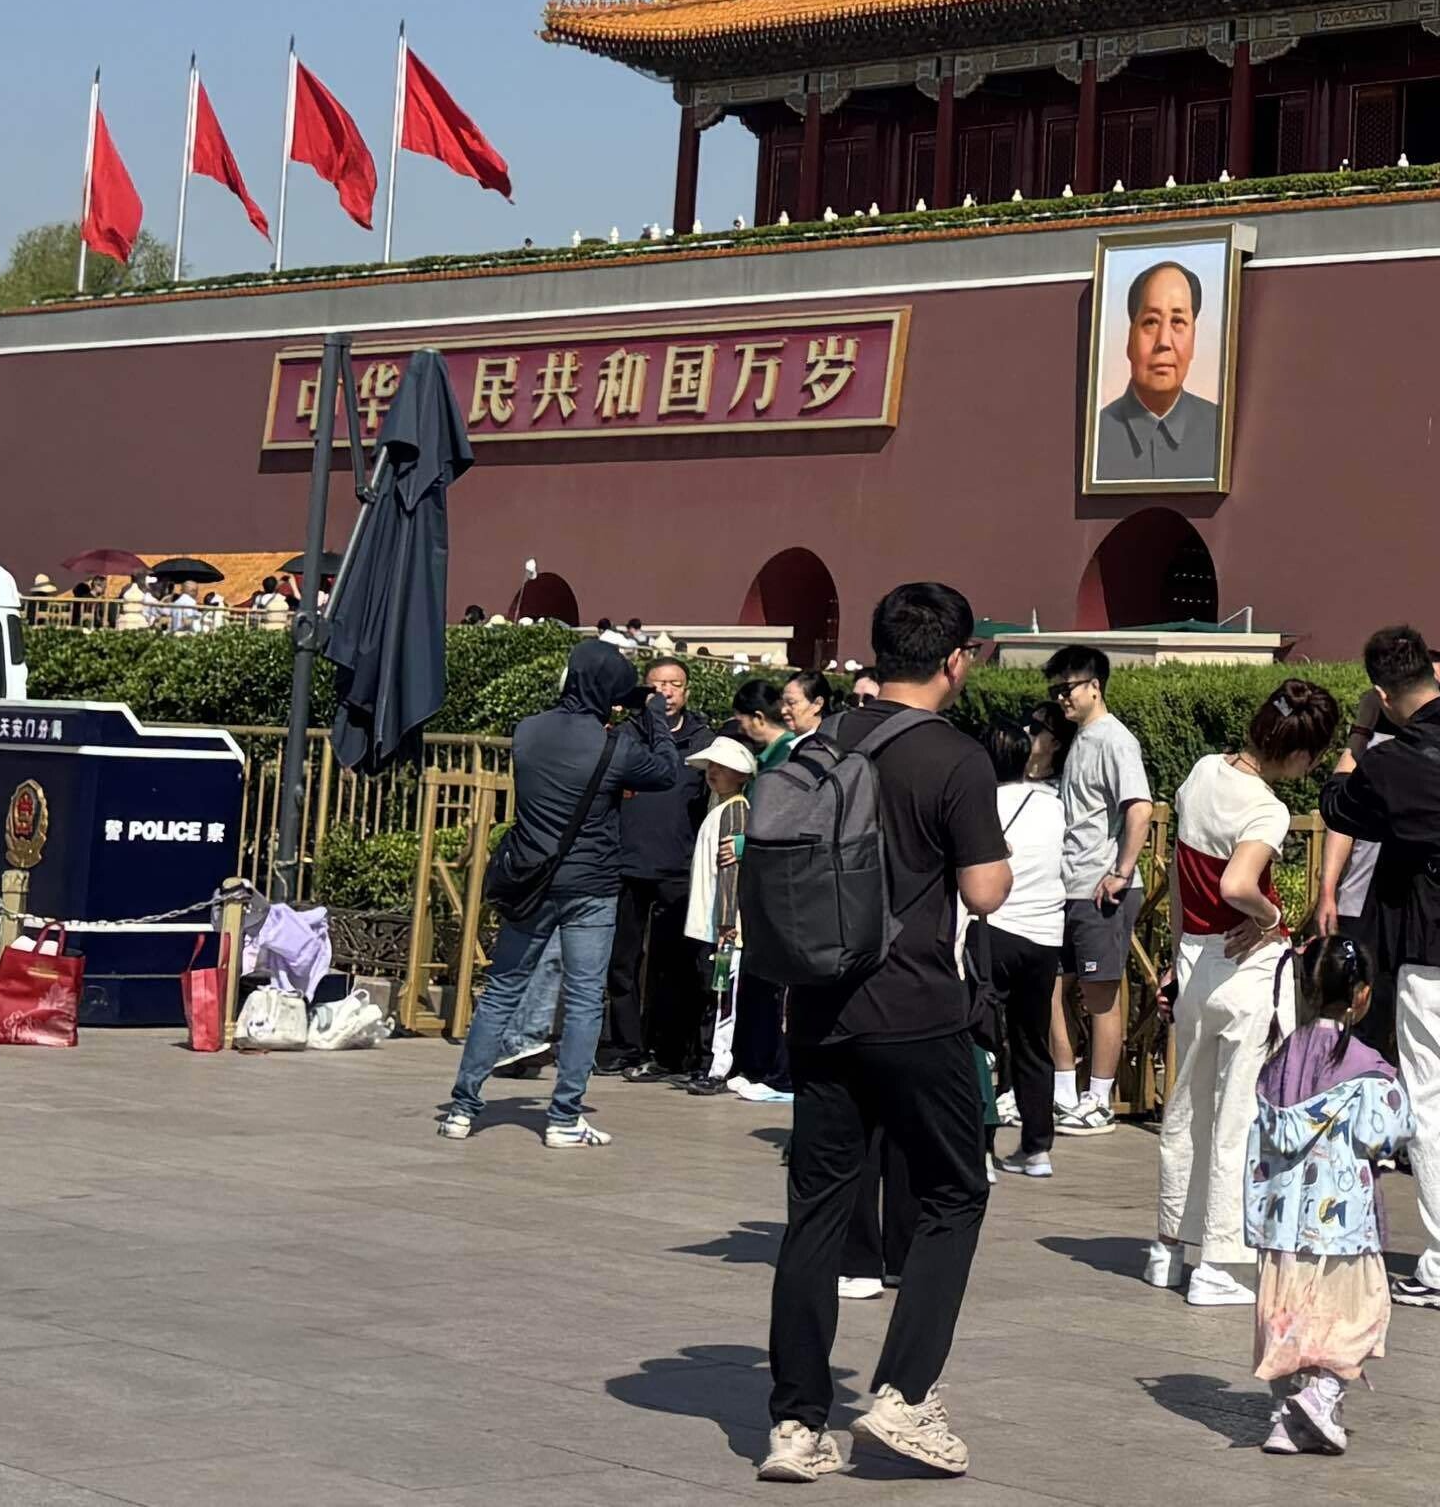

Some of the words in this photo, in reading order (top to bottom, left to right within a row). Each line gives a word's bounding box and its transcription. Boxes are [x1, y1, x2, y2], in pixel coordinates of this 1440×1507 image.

[296, 334, 860, 432] 中华民共和国万岁
[128, 820, 202, 842] POLICE
